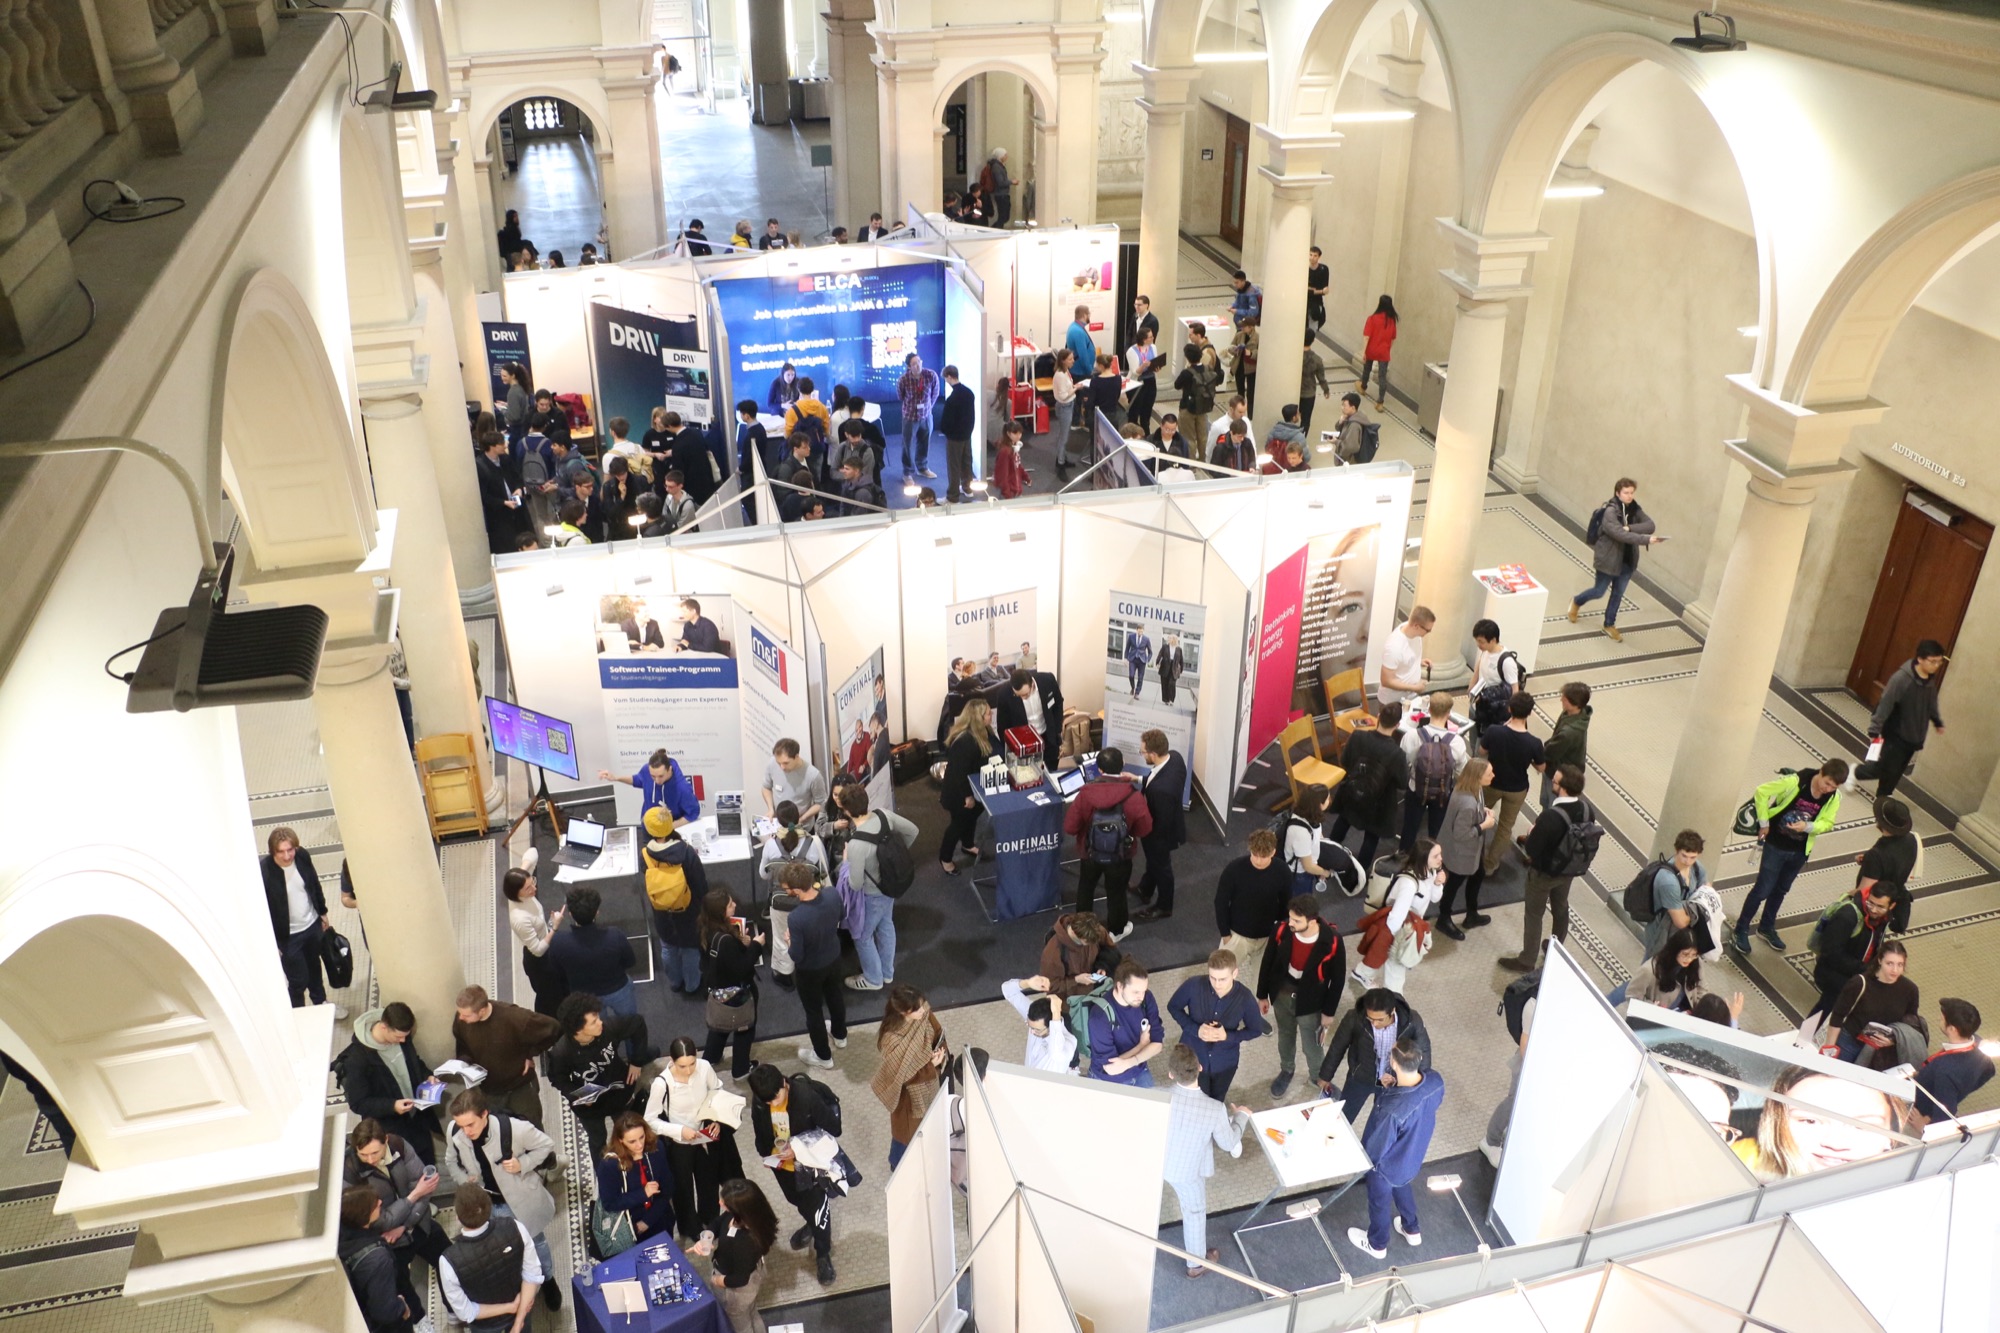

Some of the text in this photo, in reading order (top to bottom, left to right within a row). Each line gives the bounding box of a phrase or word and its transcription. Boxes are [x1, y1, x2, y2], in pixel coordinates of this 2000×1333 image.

[814, 273, 862, 291] ELCA
[754, 297, 909, 320] Job opportunities in JAVA & .NET
[492, 330, 518, 342] DRW
[609, 322, 660, 356] DRW
[740, 338, 835, 354] Software Engineers
[742, 354, 829, 371] Business Analysts
[1892, 442, 1966, 487] AUDITORIUM E3
[1305, 582, 1341, 595] opportunity
[1311, 575, 1333, 586] unique
[1326, 591, 1339, 601] part
[955, 601, 1018, 625] CONFINALE
[1118, 602, 1185, 625] CONFINALE
[1312, 600, 1343, 611] extremely
[1264, 604, 1296, 635] Rethinking
[1302, 611, 1328, 621] talented
[1301, 620, 1334, 630] workforce,
[1262, 625, 1284, 648] energy
[1300, 633, 1347, 648] work with areas
[1301, 630, 1320, 639] allows
[752, 636, 778, 669] m&f
[1262, 638, 1284, 660] trading.
[1312, 641, 1350, 654] technologies
[1312, 650, 1345, 662] passionate
[647, 666, 721, 674] Trainee-Programm
[840, 666, 876, 710] CONFINALE
[996, 832, 1058, 853] CONFINALE
